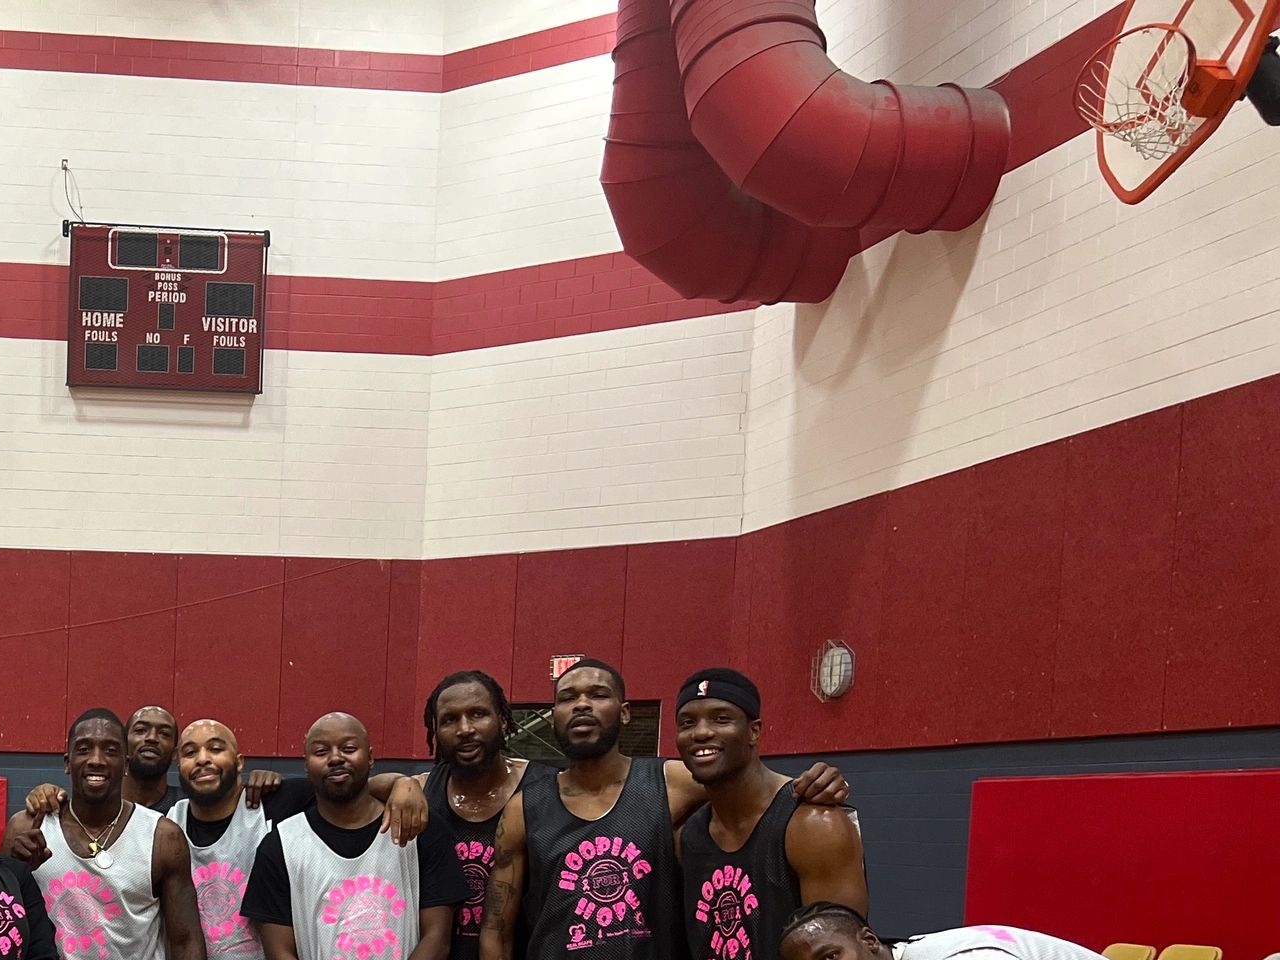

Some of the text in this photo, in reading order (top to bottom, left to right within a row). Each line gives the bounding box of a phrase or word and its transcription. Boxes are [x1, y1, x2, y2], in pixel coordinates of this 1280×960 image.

[154, 272, 182, 282] BONUS
[157, 281, 178, 291] POSS
[148, 290, 187, 303] PERIOD
[81, 311, 124, 328] HOME
[201, 316, 258, 334] VISITOR
[84, 330, 118, 342] FOULS
[145, 332, 161, 344] NO
[183, 334, 190, 345] F
[213, 335, 246, 348] FOULS
[558, 836, 653, 891] HOOPING
[574, 888, 641, 928] HOPE
